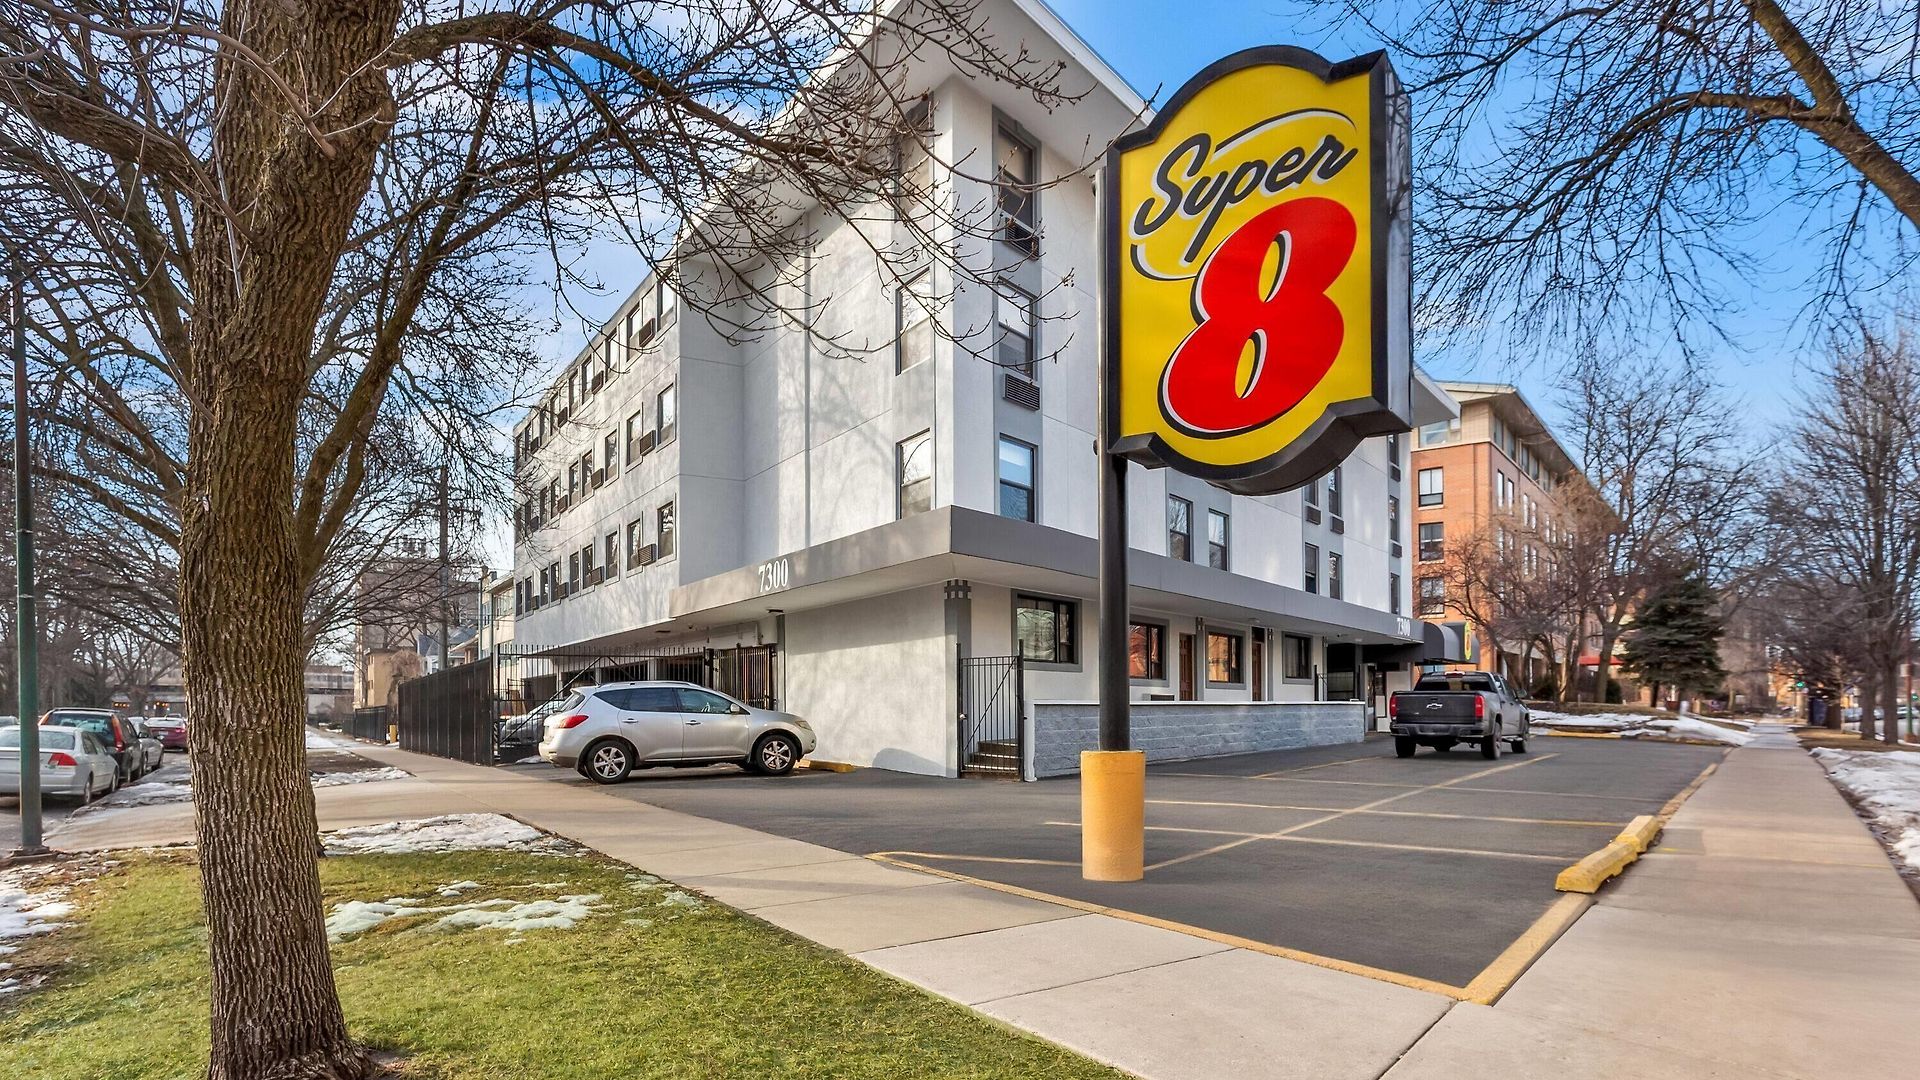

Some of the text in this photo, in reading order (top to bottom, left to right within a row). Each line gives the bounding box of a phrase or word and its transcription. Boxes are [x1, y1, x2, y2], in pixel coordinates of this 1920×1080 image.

[1131, 132, 1358, 264] Super
[1158, 197, 1357, 438] 8
[758, 558, 789, 593] 7300
